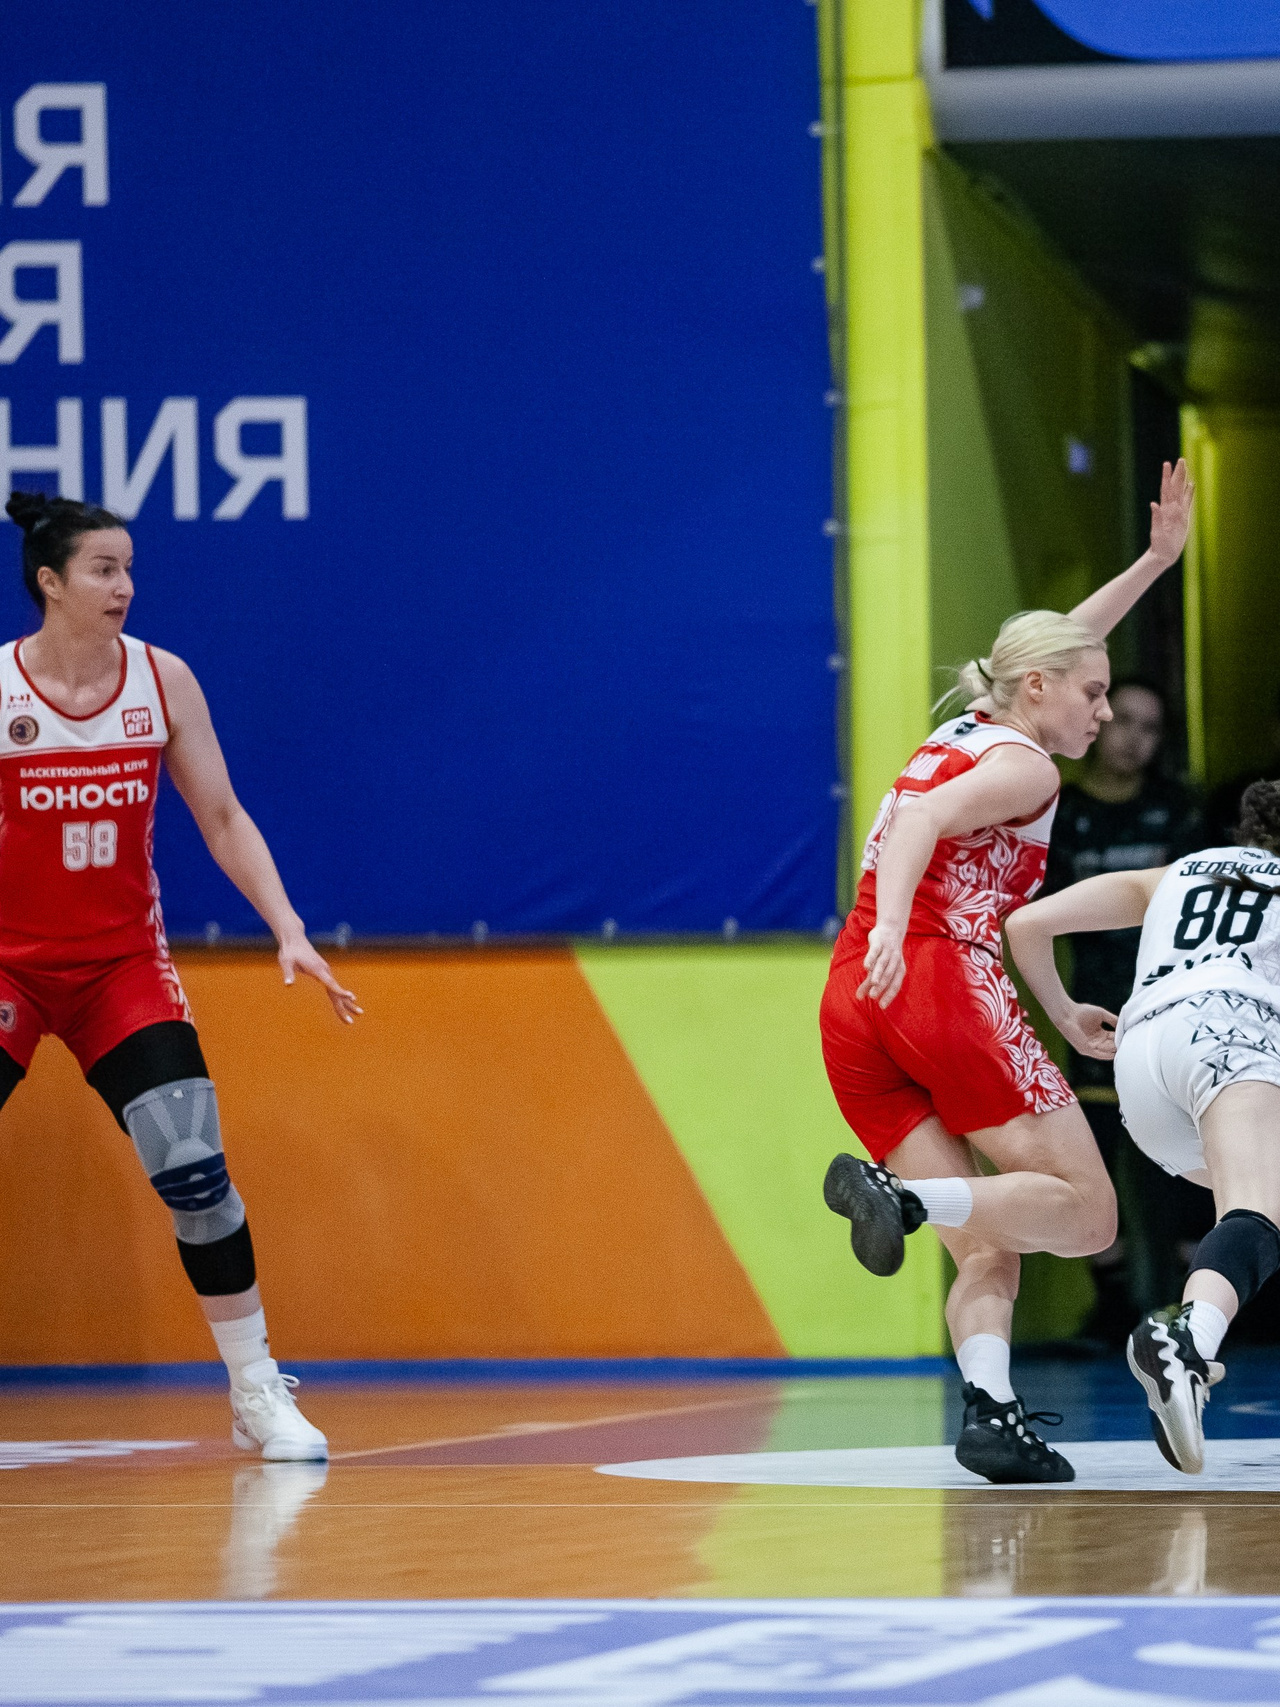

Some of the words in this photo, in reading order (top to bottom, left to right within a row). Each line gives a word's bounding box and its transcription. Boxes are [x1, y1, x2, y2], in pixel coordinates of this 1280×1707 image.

[0, 82, 109, 207] Я
[0, 240, 85, 365] Я
[0, 396, 309, 521] НИЯ
[124, 710, 149, 723] FON
[126, 721, 151, 735] BET
[20, 779, 149, 811] ЮНОСТЬ
[62, 819, 118, 872] 58
[1174, 882, 1274, 950] 88
